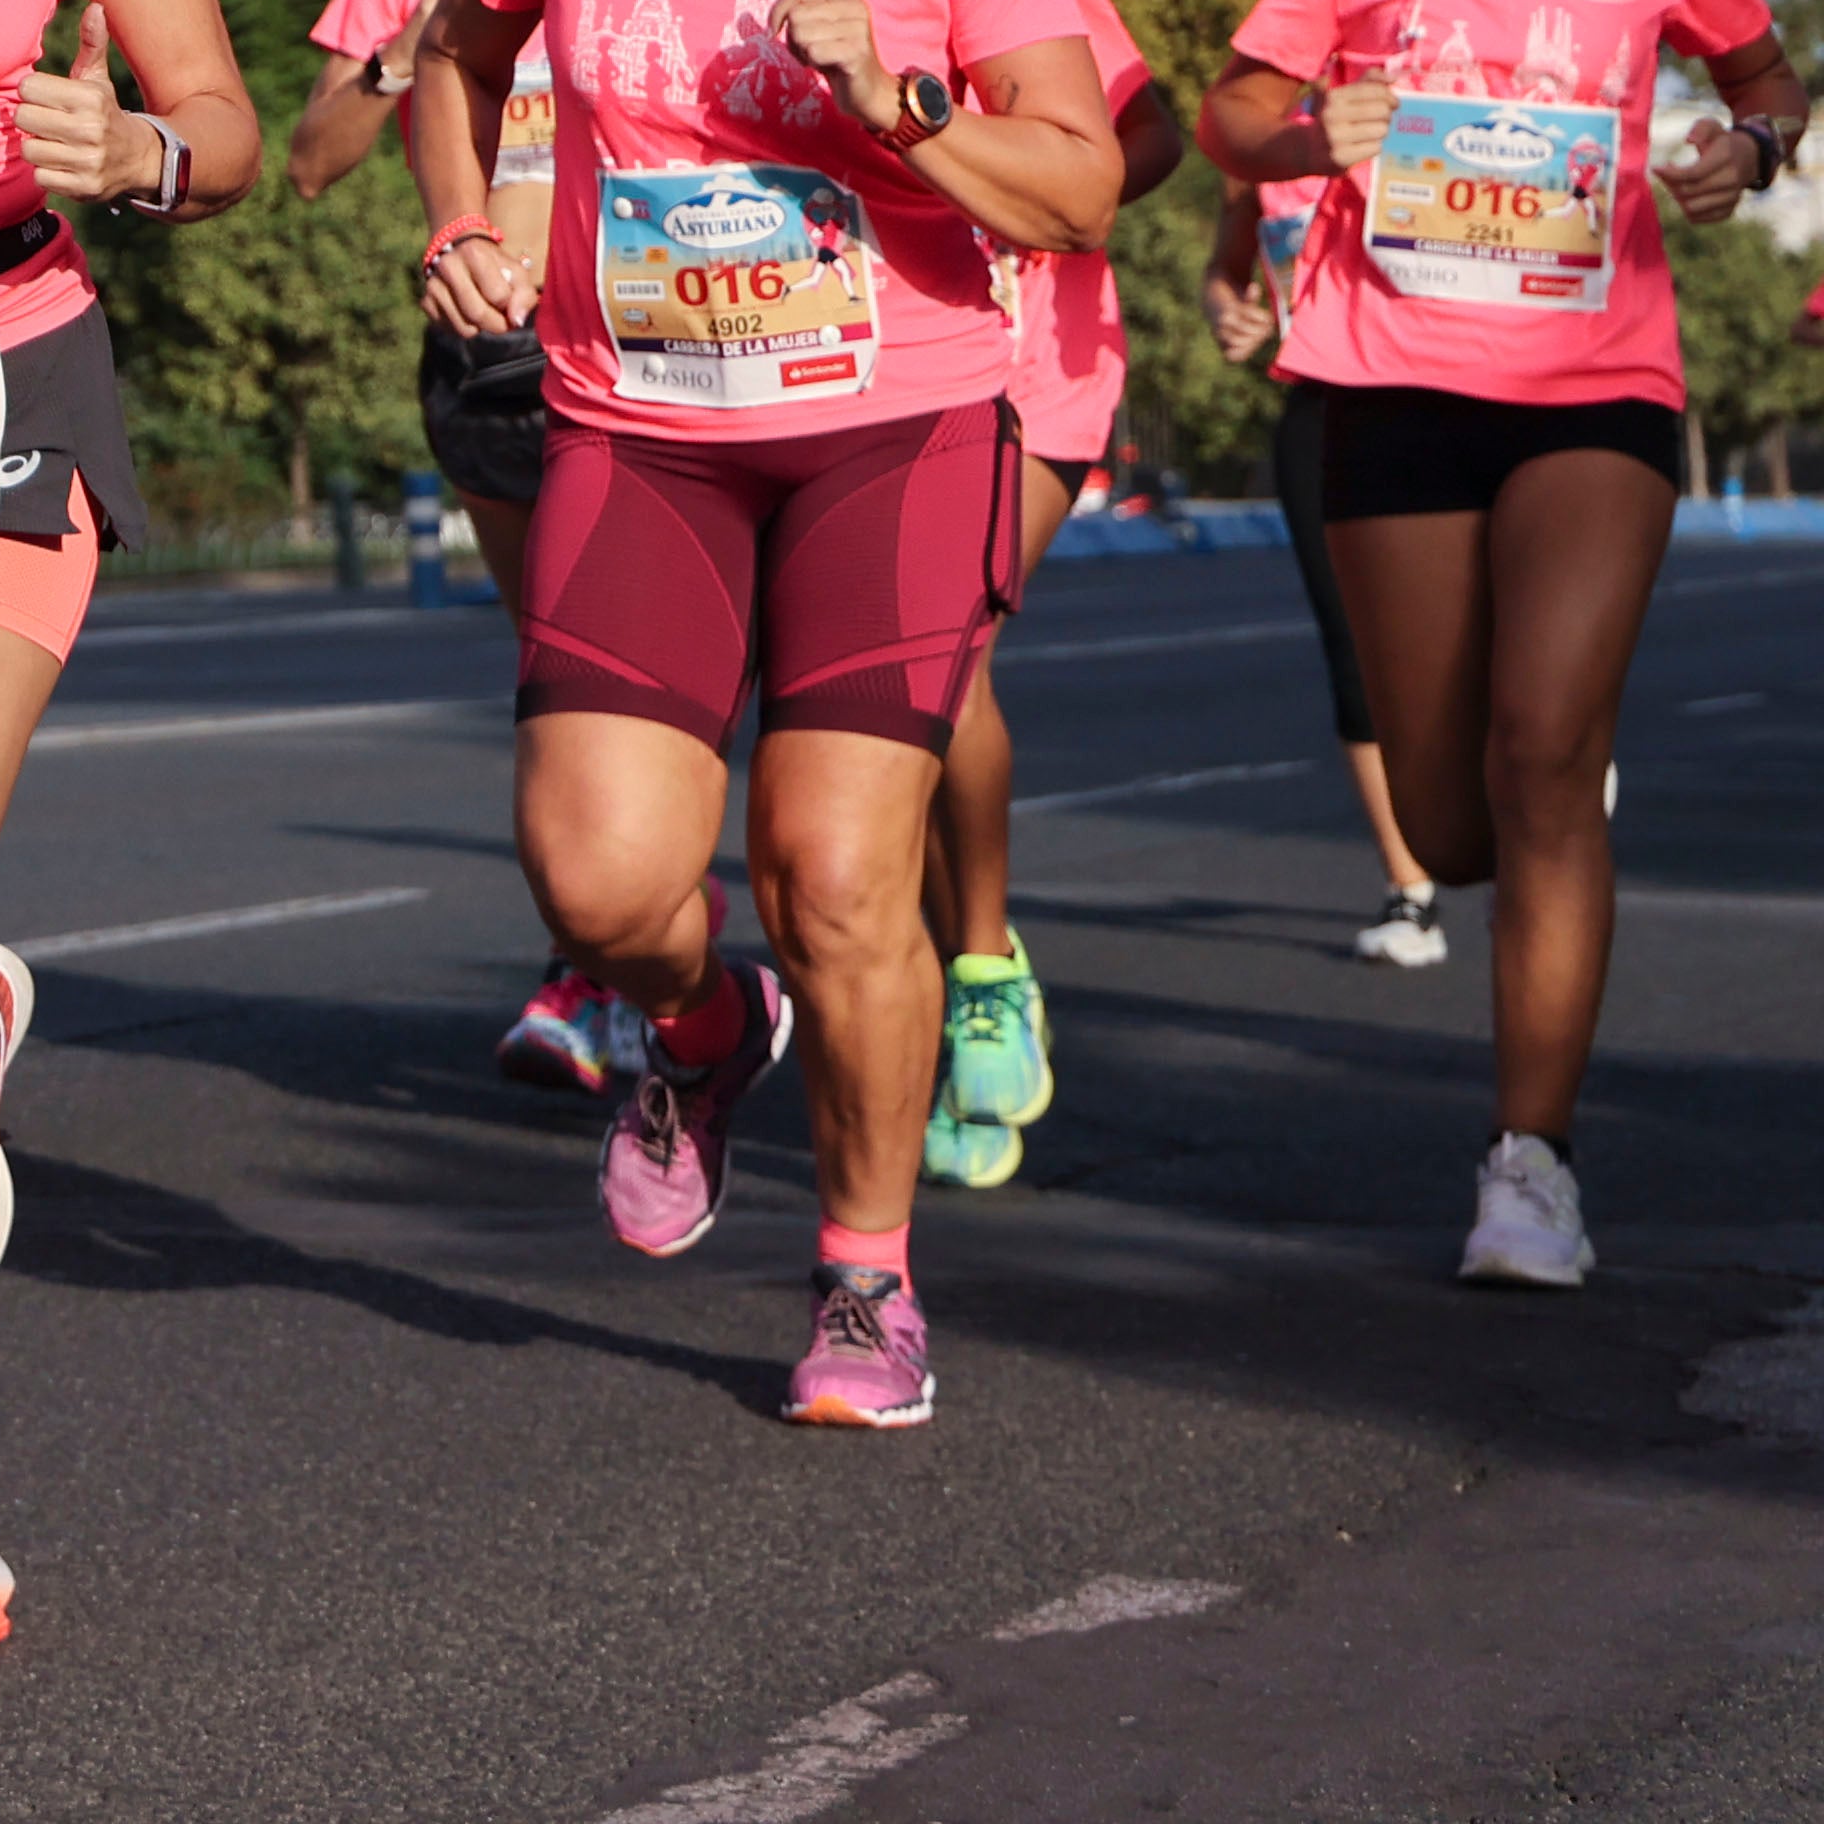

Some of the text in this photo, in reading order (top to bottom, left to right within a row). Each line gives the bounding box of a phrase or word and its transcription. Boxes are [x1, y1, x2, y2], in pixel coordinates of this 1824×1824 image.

[1445, 177, 1542, 220] 016
[673, 213, 779, 237] ASTURIANA
[675, 260, 785, 307] 016
[707, 314, 764, 337] 4902
[663, 331, 819, 357] CARRERA DE LA MUJER
